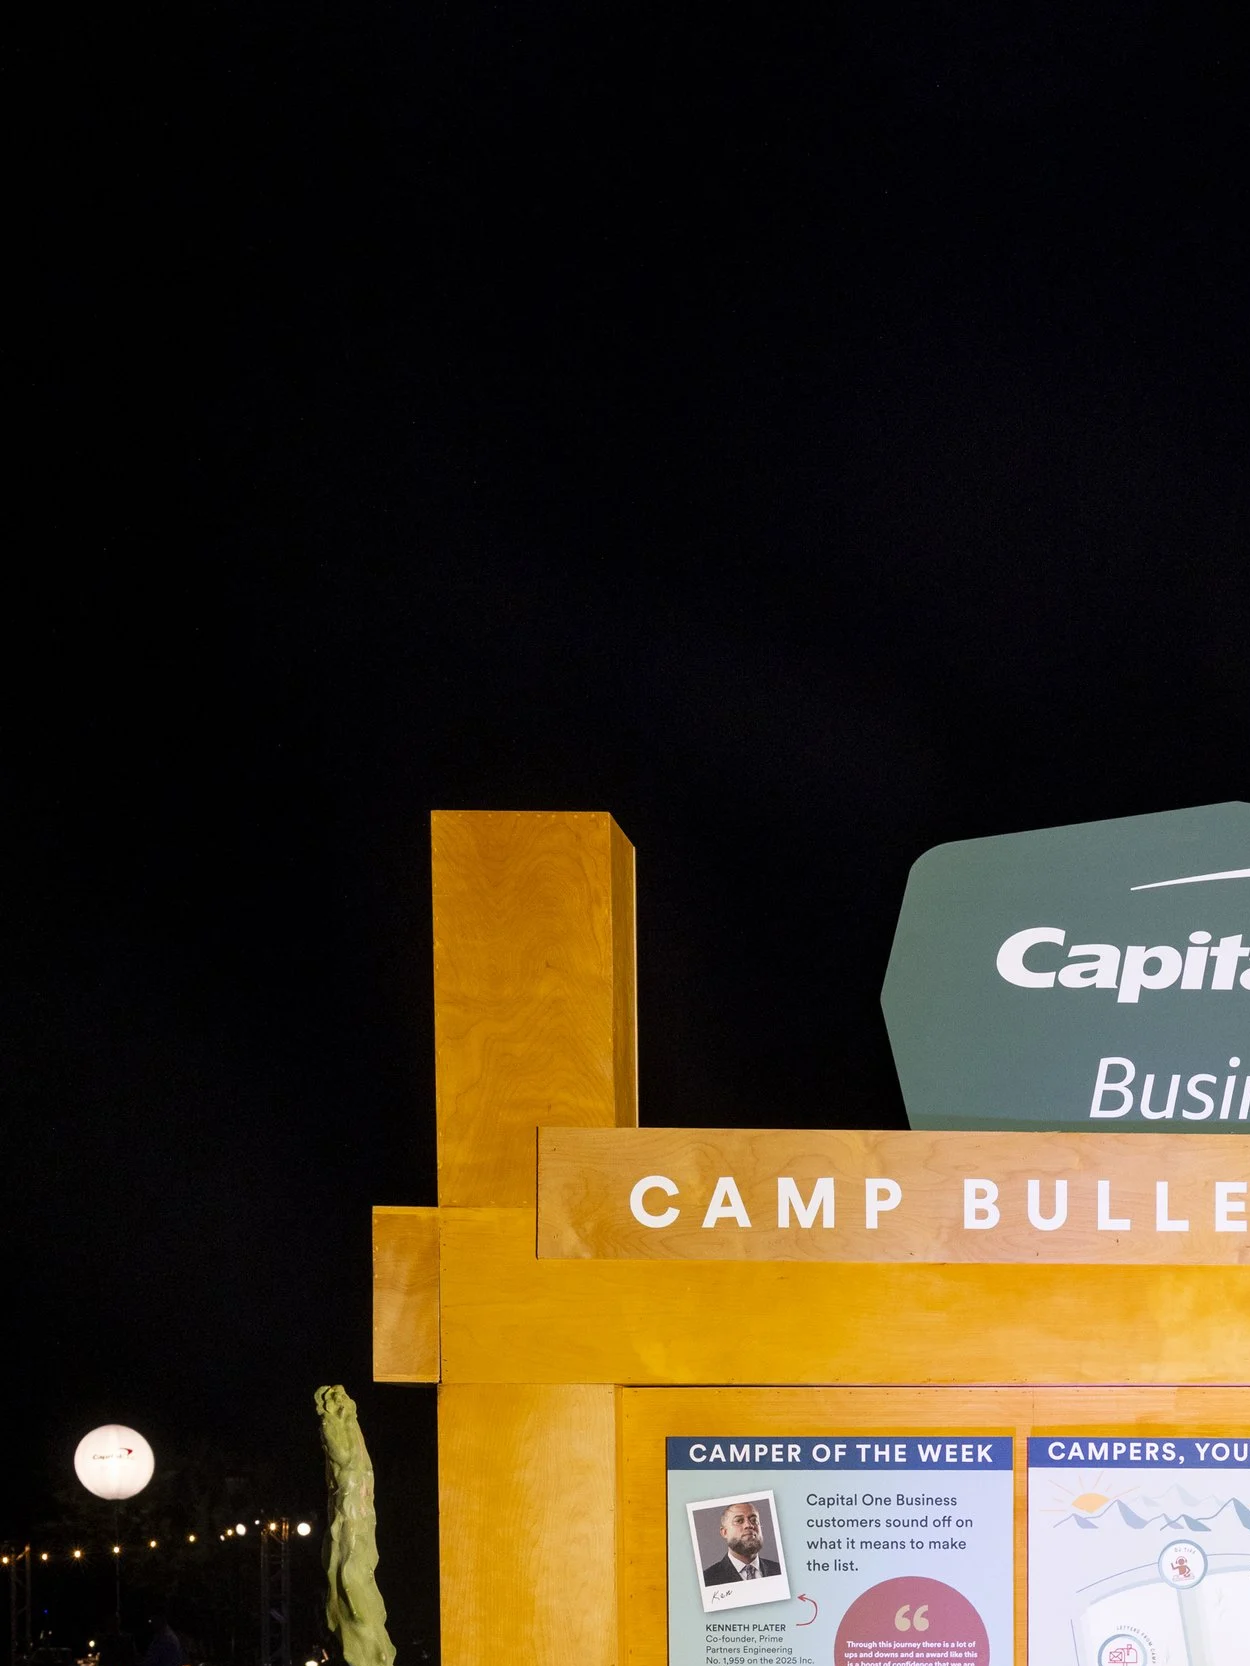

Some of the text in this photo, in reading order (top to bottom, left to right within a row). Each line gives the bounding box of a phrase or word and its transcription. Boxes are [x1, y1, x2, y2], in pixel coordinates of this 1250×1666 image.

[629, 1175, 902, 1229] CAMP
[689, 1444, 993, 1462] CAMPER OF THE WEEK
[1048, 1442, 1184, 1464] CAMPERS,
[806, 1493, 957, 1508] Capital One Business
[806, 1515, 973, 1528] customers sound off on
[806, 1537, 966, 1550] what it means to make
[806, 1559, 858, 1572] the list.
[706, 1624, 786, 1632] KENNETH PLATER
[705, 1634, 783, 1643] Co-founder, Prime
[706, 1645, 793, 1655] Partners Engineering
[706, 1656, 721, 1664] No.
[723, 1657, 745, 1665] 1,959
[776, 1656, 797, 1664] 2025
